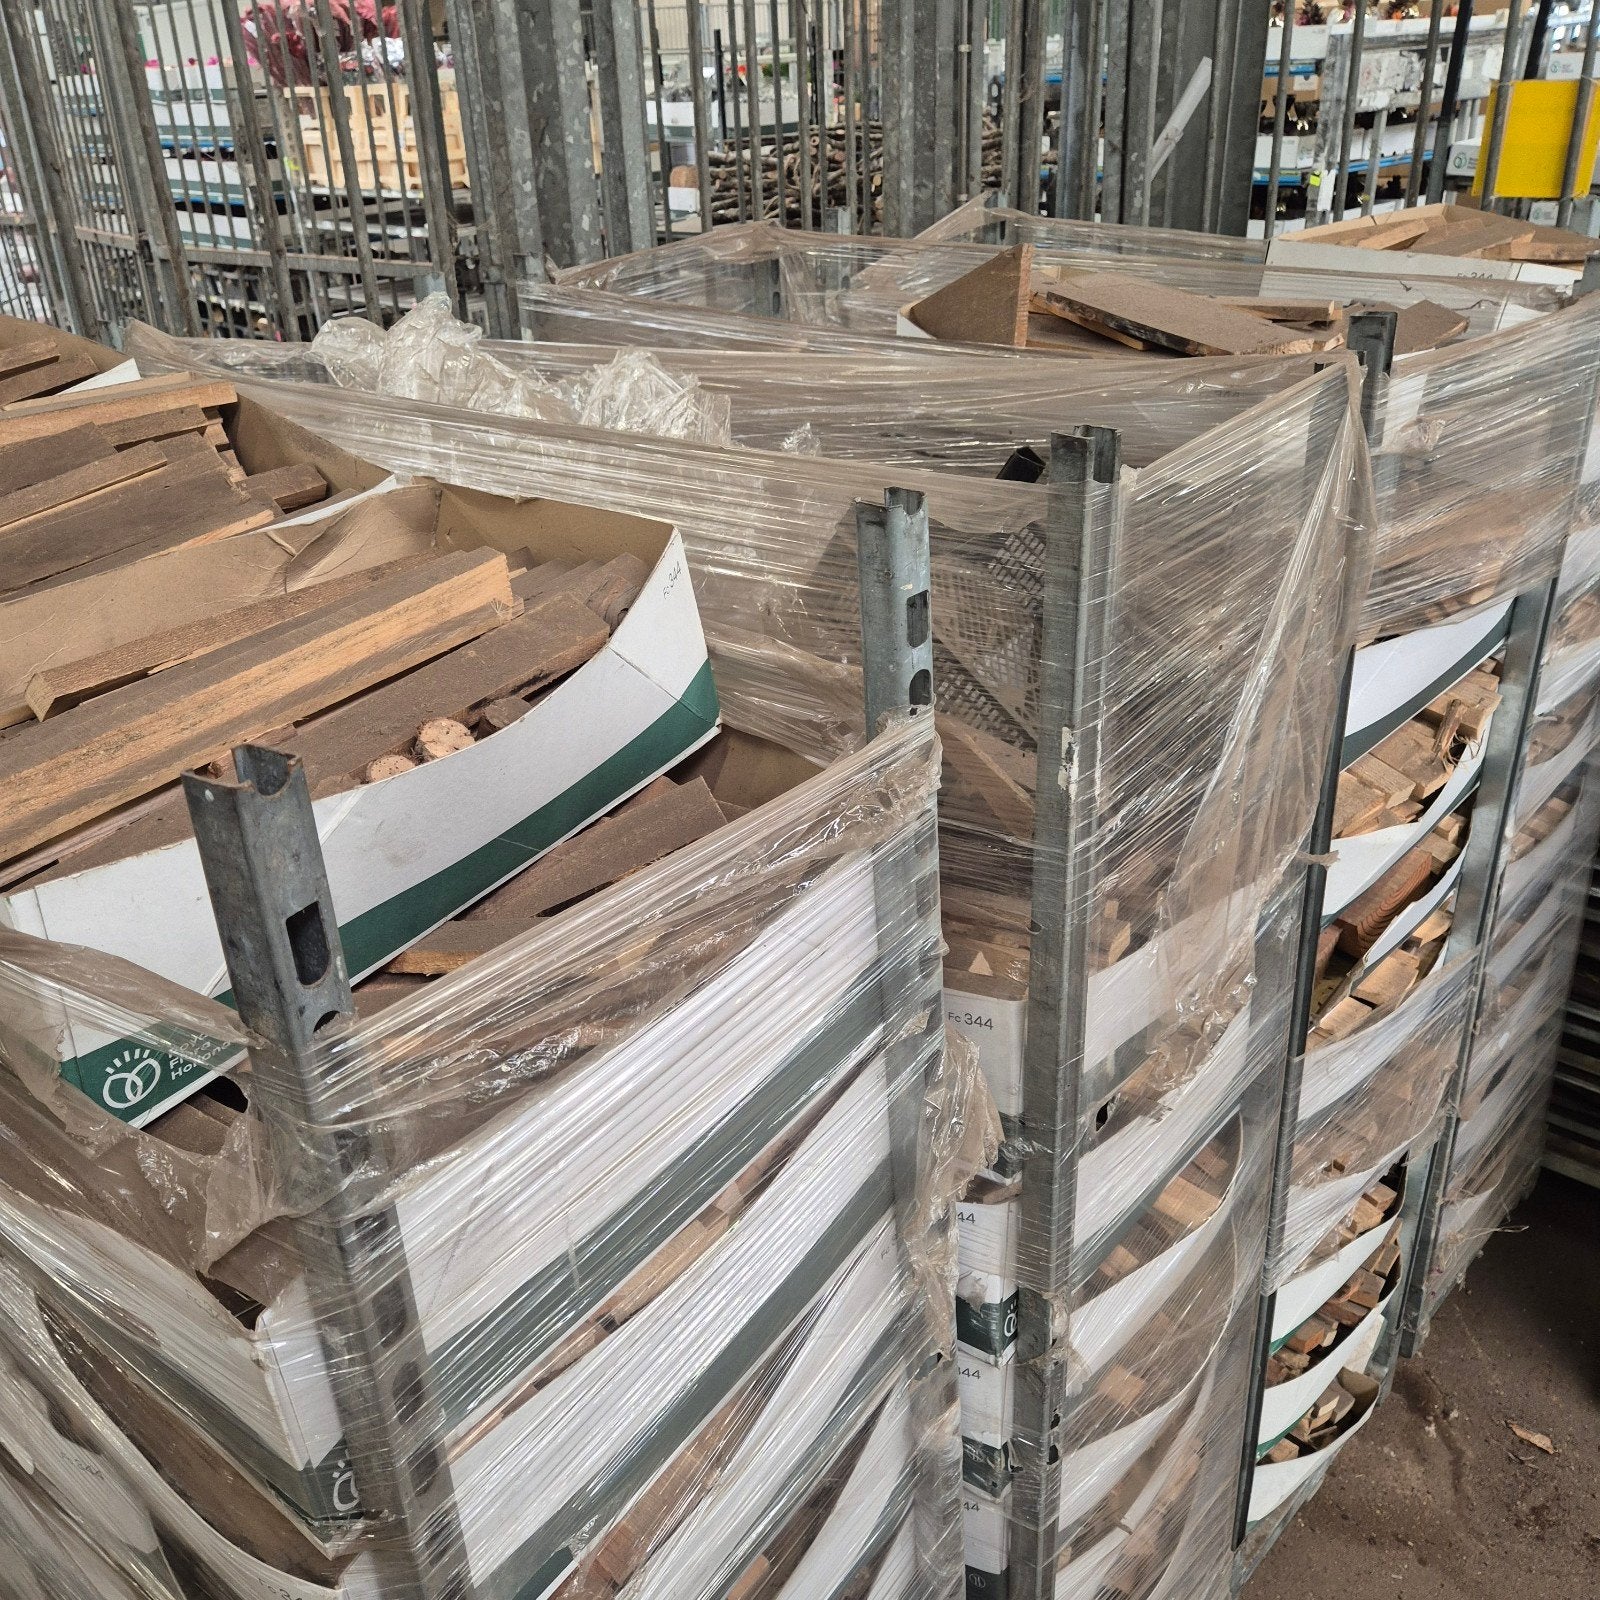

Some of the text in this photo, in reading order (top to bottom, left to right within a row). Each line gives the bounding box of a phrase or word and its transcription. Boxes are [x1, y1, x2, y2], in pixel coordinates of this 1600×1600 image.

[668, 560, 682, 588] 344
[948, 1011, 994, 1030] Fc 344
[170, 1041, 211, 1070] Flra
[171, 1037, 233, 1081] Hoand
[957, 1211, 976, 1224] 44
[958, 1366, 981, 1380] 44
[963, 1501, 980, 1513] 44
